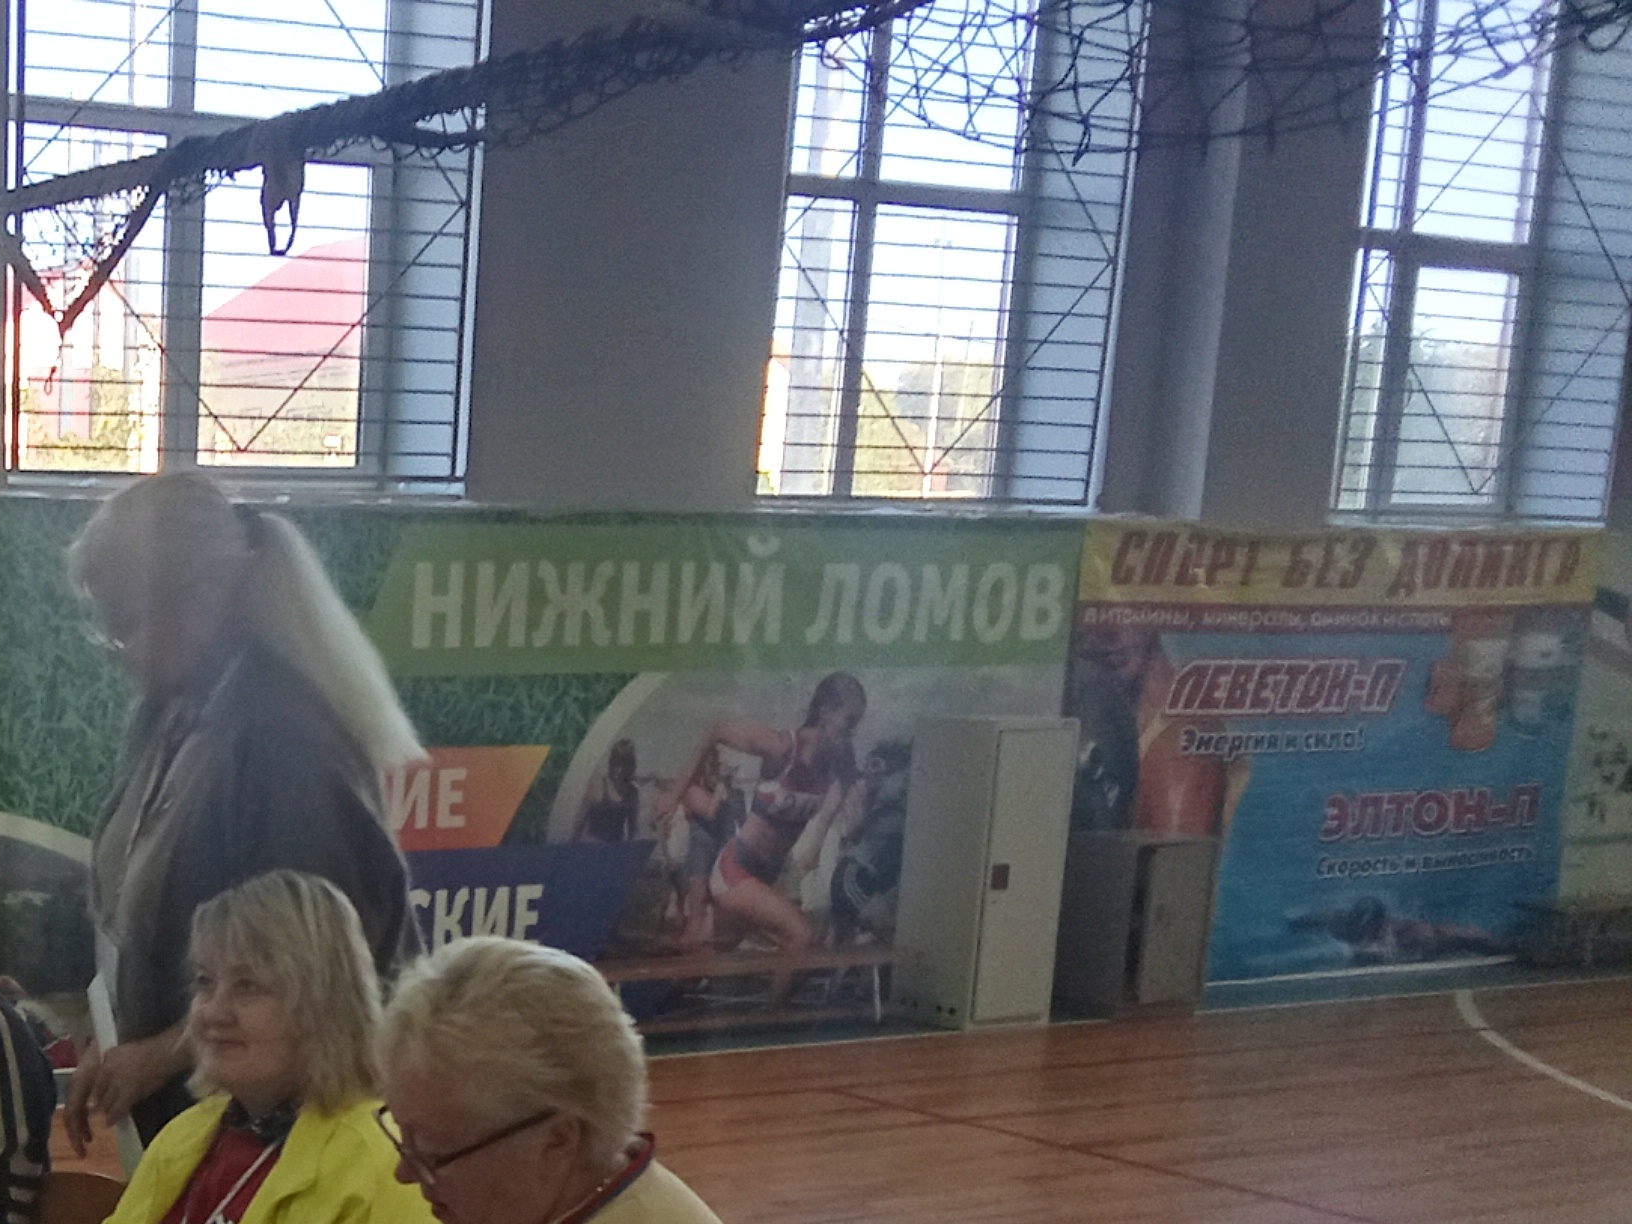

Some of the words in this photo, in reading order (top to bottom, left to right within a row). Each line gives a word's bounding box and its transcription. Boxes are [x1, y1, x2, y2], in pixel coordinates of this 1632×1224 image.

[1281, 534, 1378, 589] БЕЗ
[411, 536, 785, 650] НИЖНИЙ
[804, 562, 1066, 648] ЛОМОВ
[1181, 727, 1280, 761] Энергия
